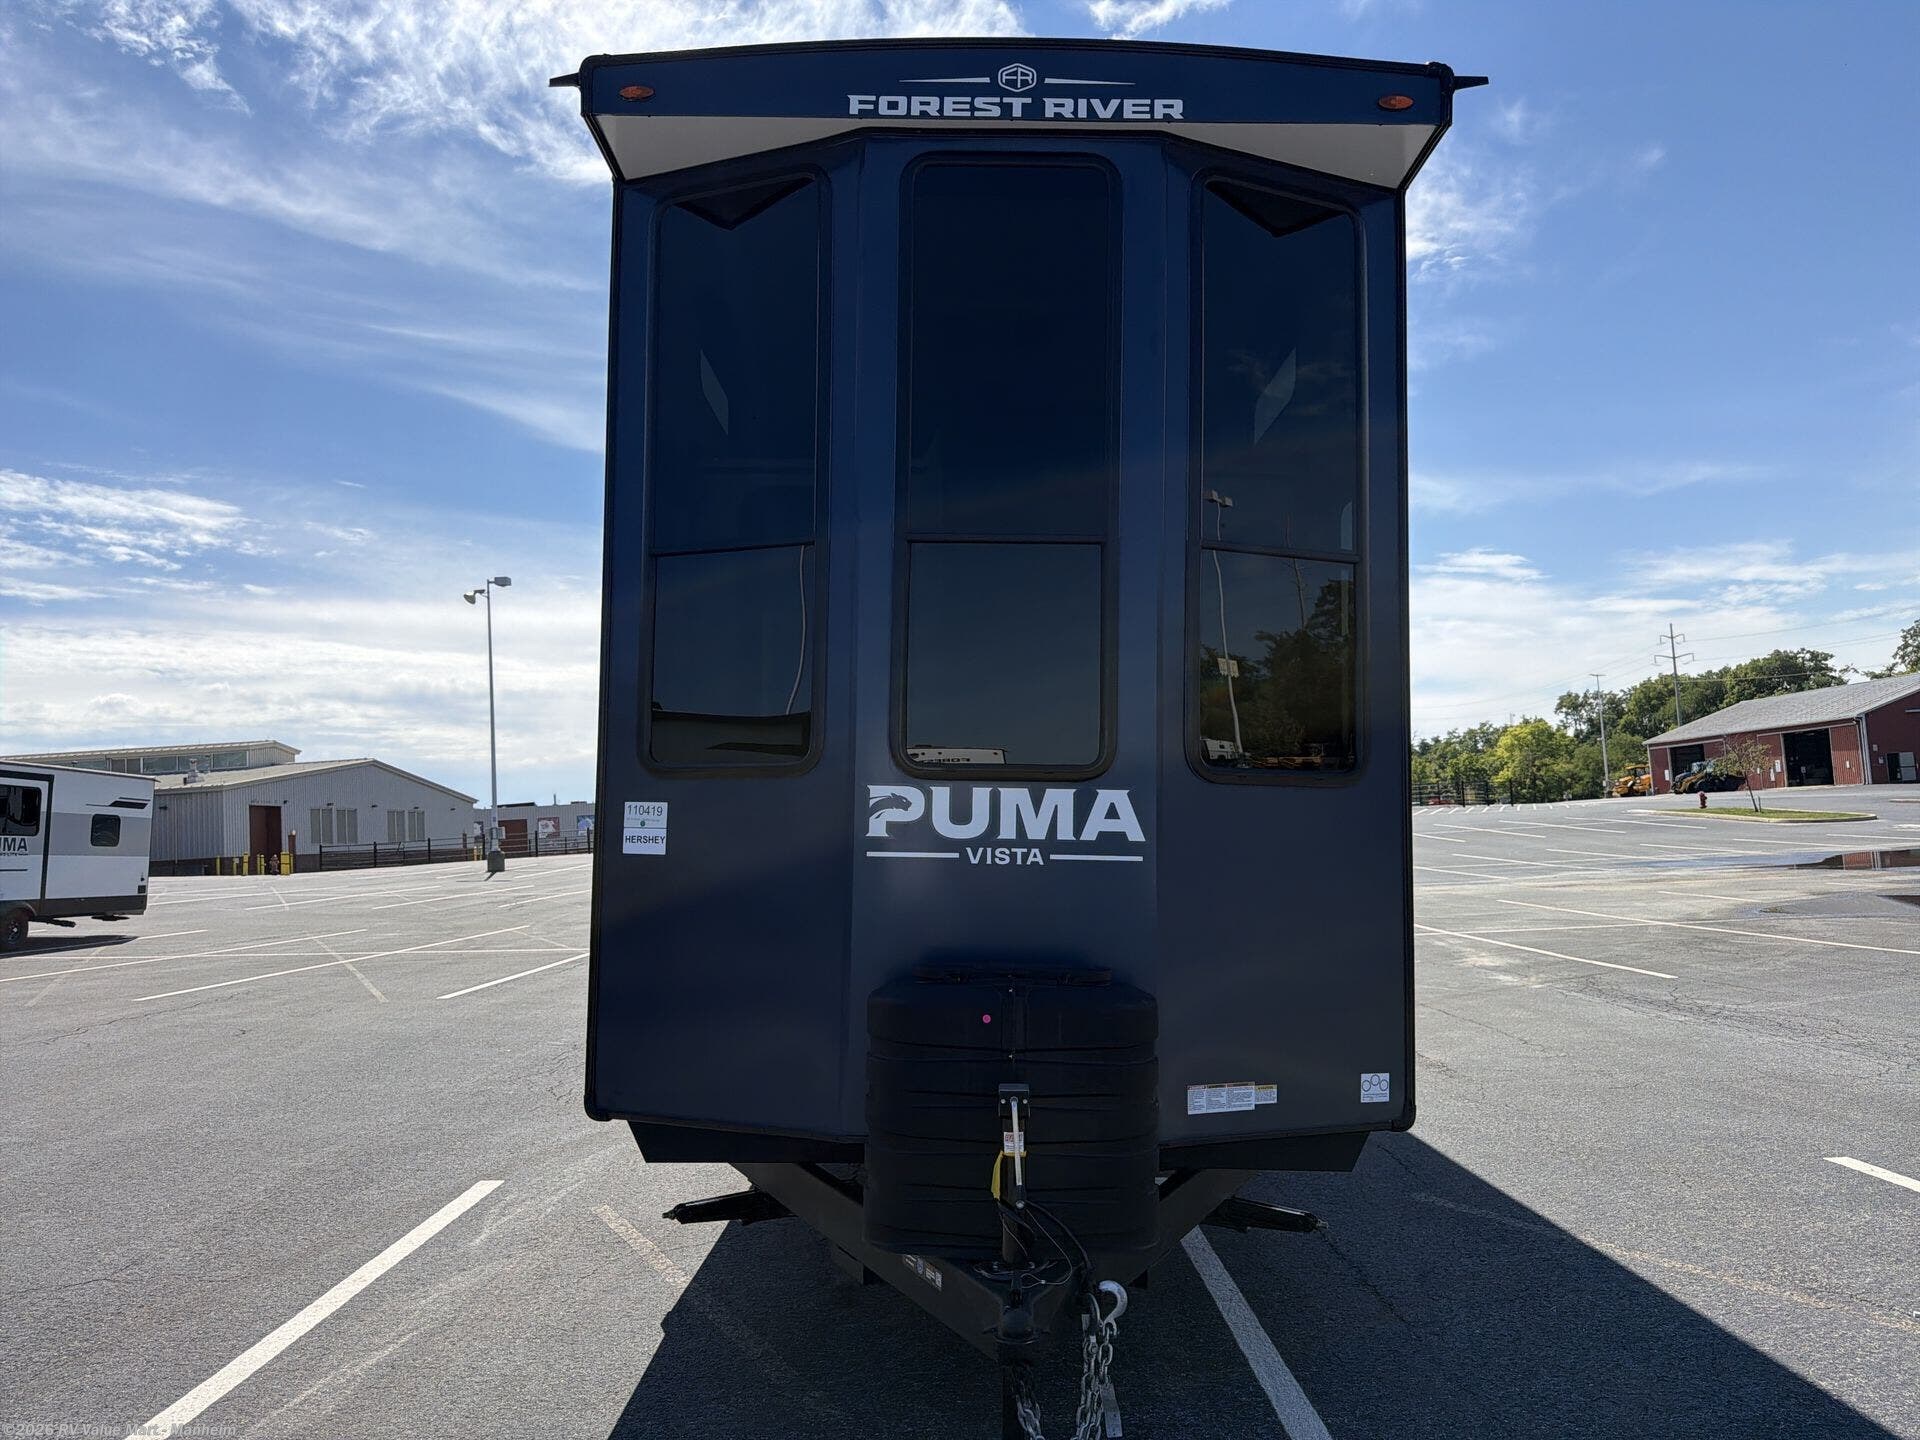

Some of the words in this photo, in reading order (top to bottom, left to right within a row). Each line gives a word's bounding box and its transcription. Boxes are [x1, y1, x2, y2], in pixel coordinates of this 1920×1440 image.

[847, 95, 1031, 118] FOREST
[1044, 98, 1184, 119] RIVER
[627, 805, 663, 816] 110419
[865, 784, 1146, 842] PUMA
[0, 837, 28, 852] MA
[625, 835, 665, 844] HERSHEY
[965, 847, 1045, 865] VISTA
